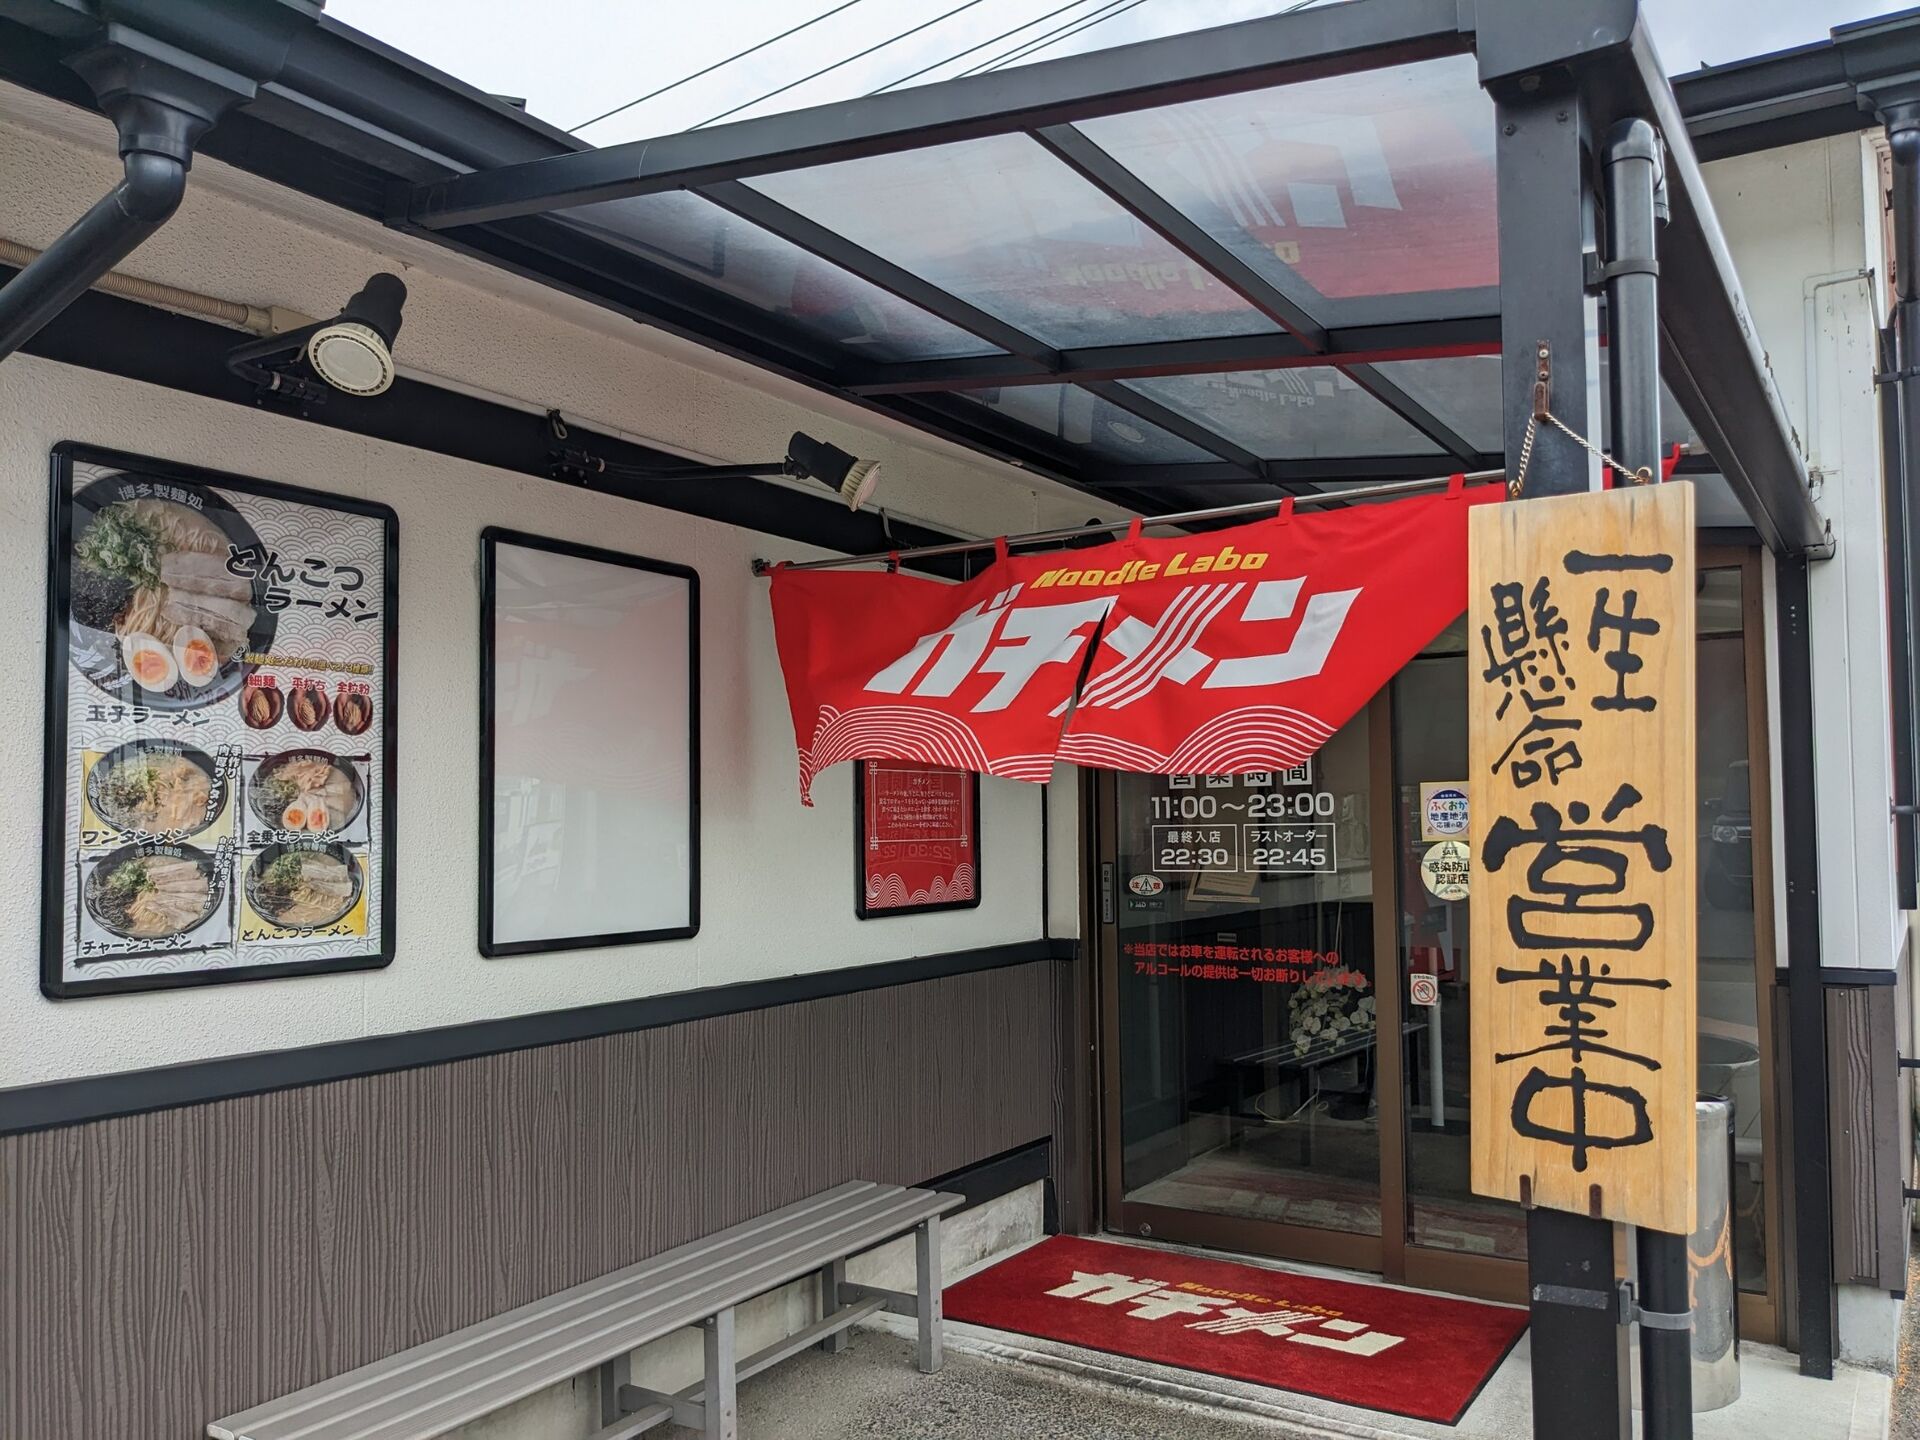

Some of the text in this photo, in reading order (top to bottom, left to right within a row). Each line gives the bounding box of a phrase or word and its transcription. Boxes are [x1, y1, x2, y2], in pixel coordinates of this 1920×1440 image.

[225, 544, 365, 591] とんこつ
[1030, 546, 1269, 590] Noodle Labo
[265, 587, 379, 622] ラーメン
[863, 574, 1364, 717] ガチメン
[248, 675, 276, 688] 細麺
[292, 677, 326, 691] 平打ち
[337, 682, 370, 695] 全粒粉
[86, 704, 210, 727] 玉子ラーメン
[1431, 801, 1468, 811] ふくおか
[82, 829, 190, 846] ワンタンメン
[247, 830, 339, 844] 全乗せラーメン
[1167, 831, 1222, 844] 最終入店
[1250, 829, 1328, 843] ラストオーダー
[1161, 848, 1229, 865] 22:30
[1253, 848, 1326, 865] 22:45
[1436, 874, 1469, 885] 認証店
[241, 924, 354, 942] とんこつラーメン
[82, 936, 192, 956] チャーシューメン
[1482, 784, 1674, 1173] 営業中
[1043, 1270, 1406, 1358] ガチメン
